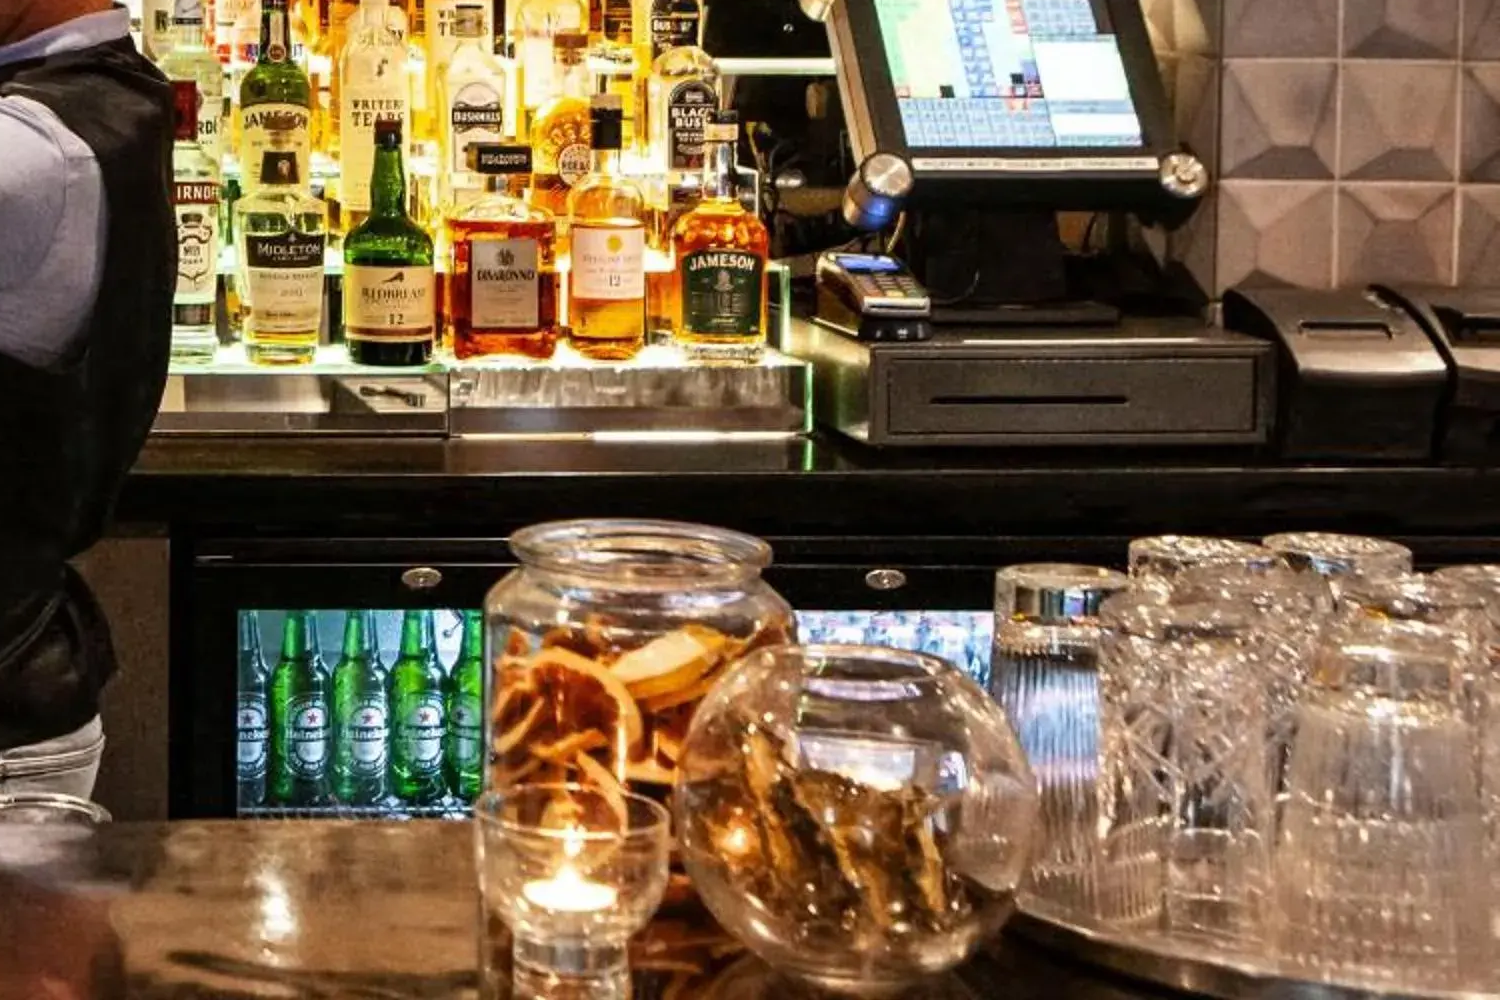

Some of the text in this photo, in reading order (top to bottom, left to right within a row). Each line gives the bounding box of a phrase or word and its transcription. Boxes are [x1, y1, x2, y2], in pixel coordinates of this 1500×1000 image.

[176, 183, 221, 198] IRNOF
[257, 242, 321, 257] MIDLETON
[689, 255, 756, 272] JAMESON
[476, 270, 536, 282] DISARONNO
[609, 274, 621, 287] 12
[388, 313, 405, 325] 12
